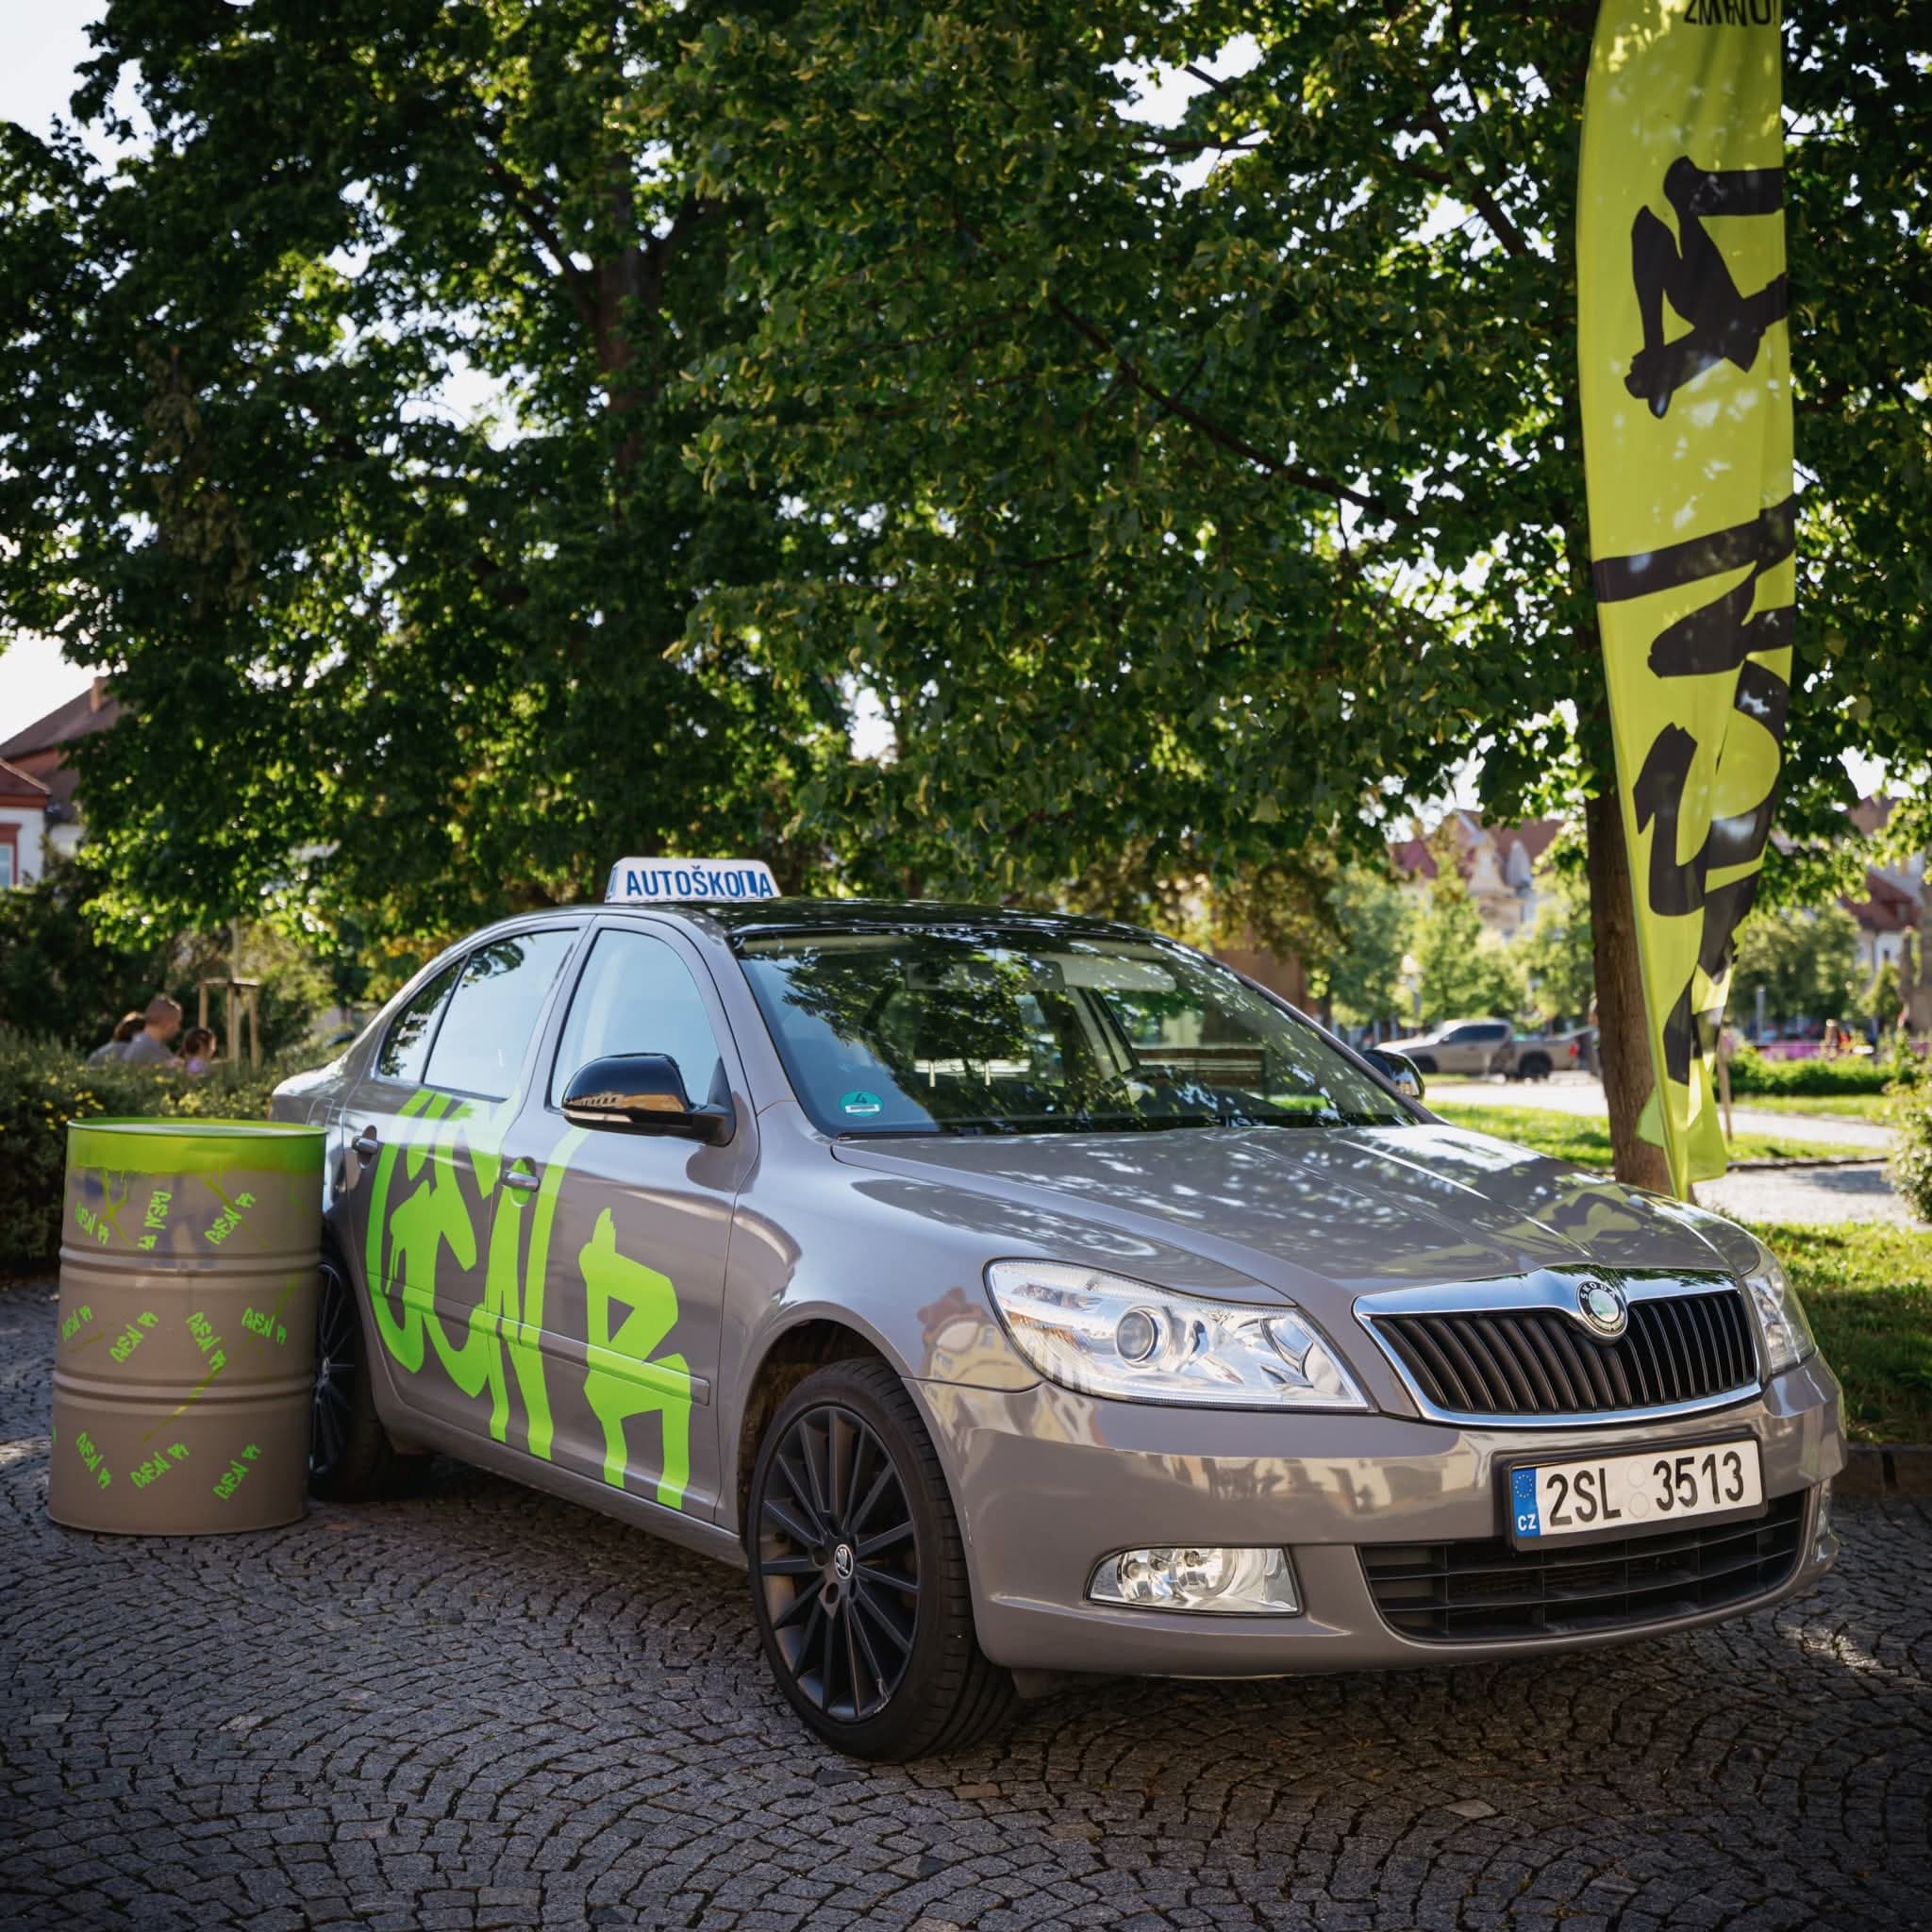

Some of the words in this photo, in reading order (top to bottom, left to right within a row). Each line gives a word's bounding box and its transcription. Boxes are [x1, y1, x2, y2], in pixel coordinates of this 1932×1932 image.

[1546, 1467, 1622, 1526] 2SL
[1653, 1450, 1744, 1511] 3513
[1518, 1513, 1537, 1531] CZ
